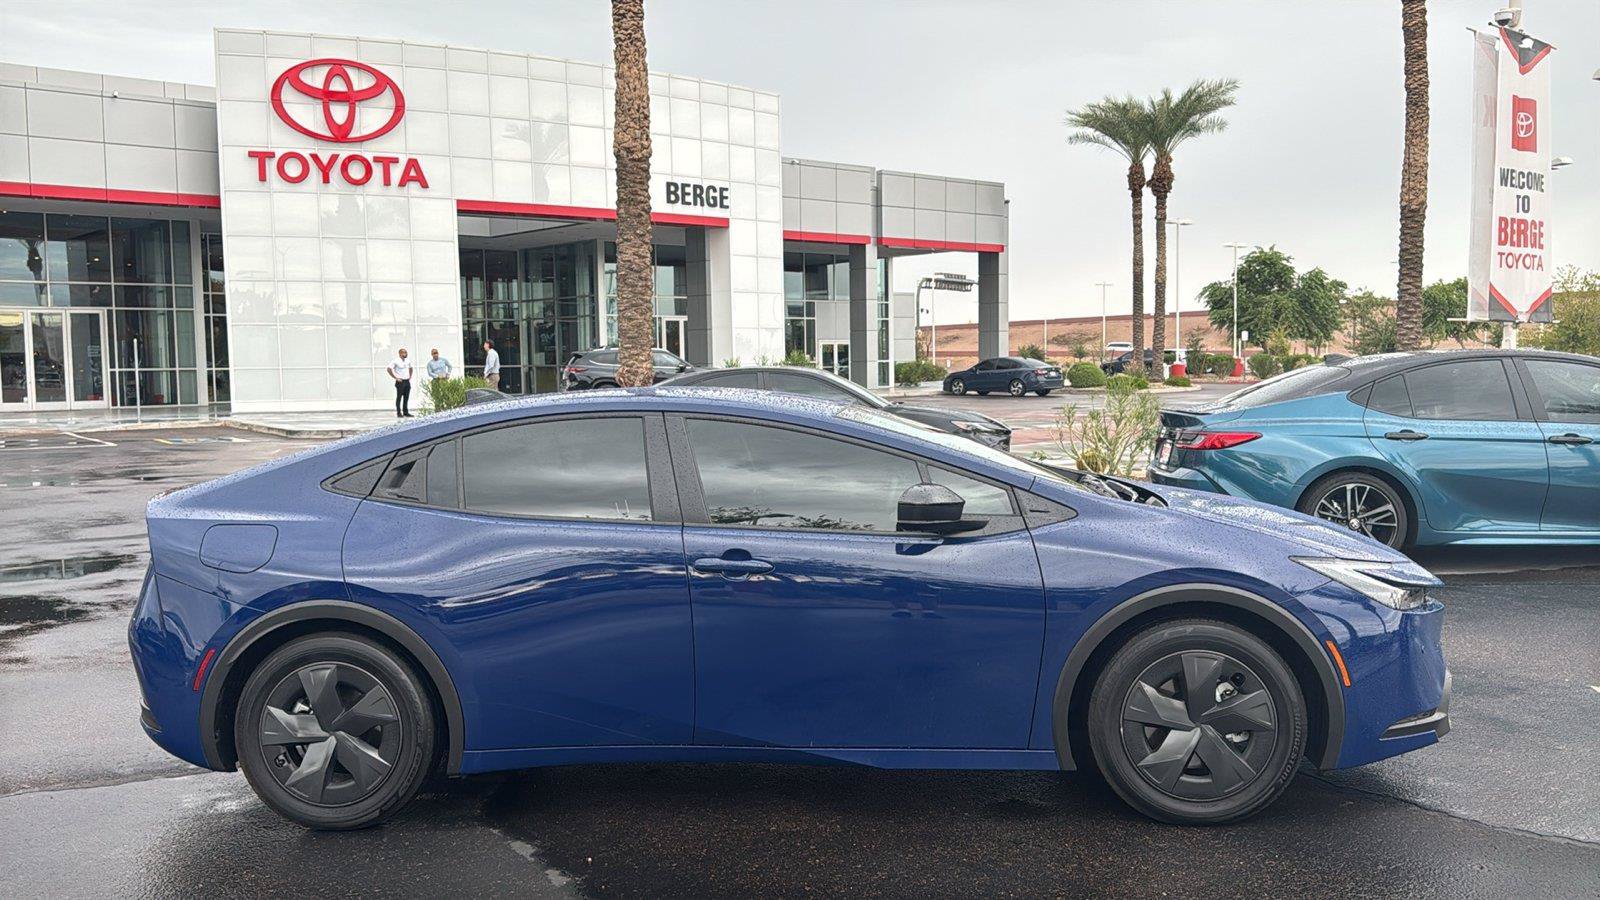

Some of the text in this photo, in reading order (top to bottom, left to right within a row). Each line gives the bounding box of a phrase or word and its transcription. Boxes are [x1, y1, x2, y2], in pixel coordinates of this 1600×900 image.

[248, 151, 429, 189] TOYOTA
[666, 181, 730, 209] BERGE
[1516, 195, 1531, 213] TO
[1498, 216, 1544, 250] BERGE
[1497, 252, 1544, 272] TOYOTA
